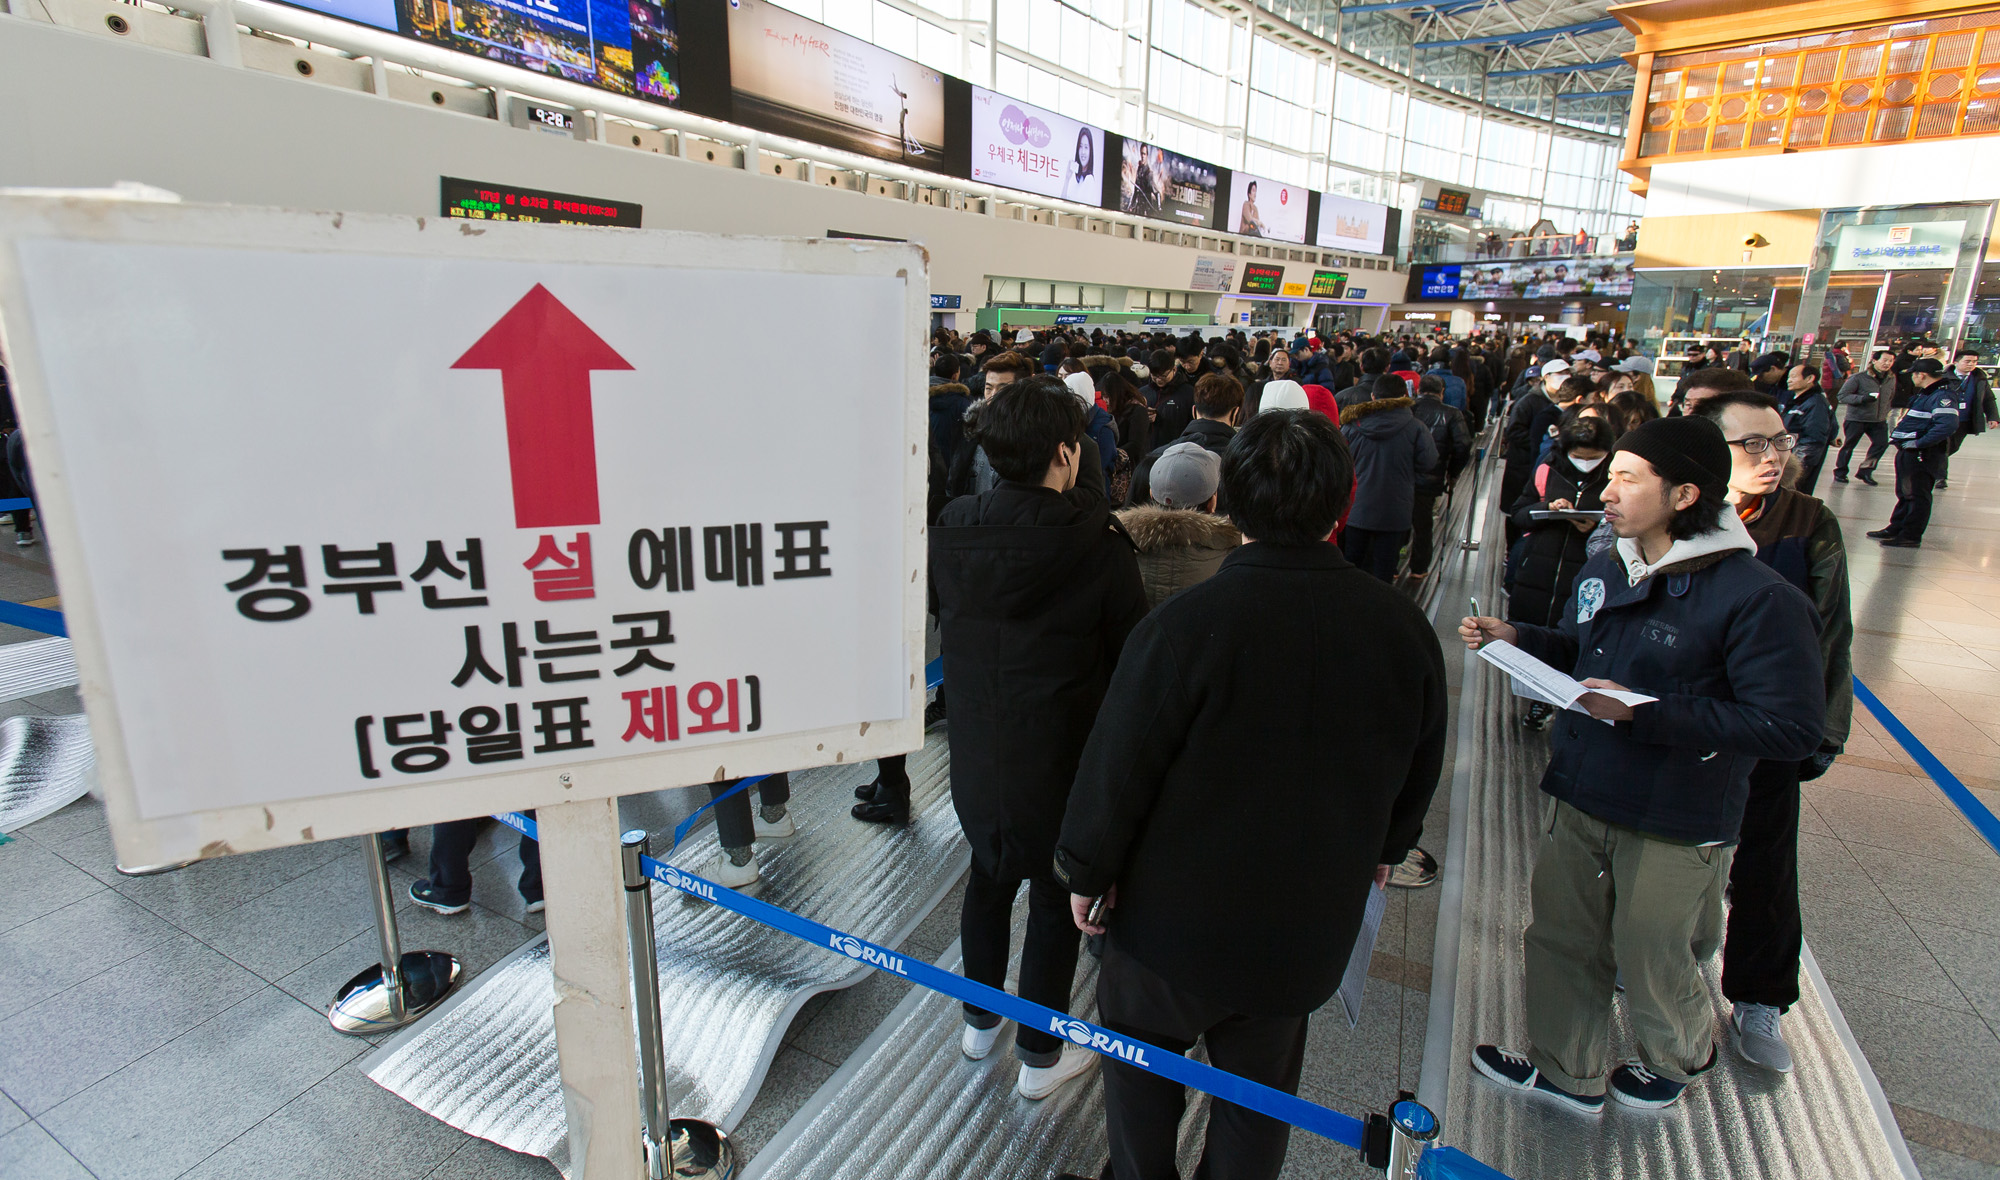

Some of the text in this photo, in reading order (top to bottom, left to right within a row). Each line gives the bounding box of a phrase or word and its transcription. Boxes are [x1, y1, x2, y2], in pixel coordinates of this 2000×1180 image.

[535, 108, 565, 128] 9:28
[988, 143, 1060, 178] 우체국 체크카드
[221, 520, 832, 623] 경부선 설 예매표
[451, 609, 676, 689] 사는곳
[653, 863, 719, 902] KORAIL
[829, 933, 908, 977] KORAIL
[1049, 1016, 1150, 1068] KORAIL
